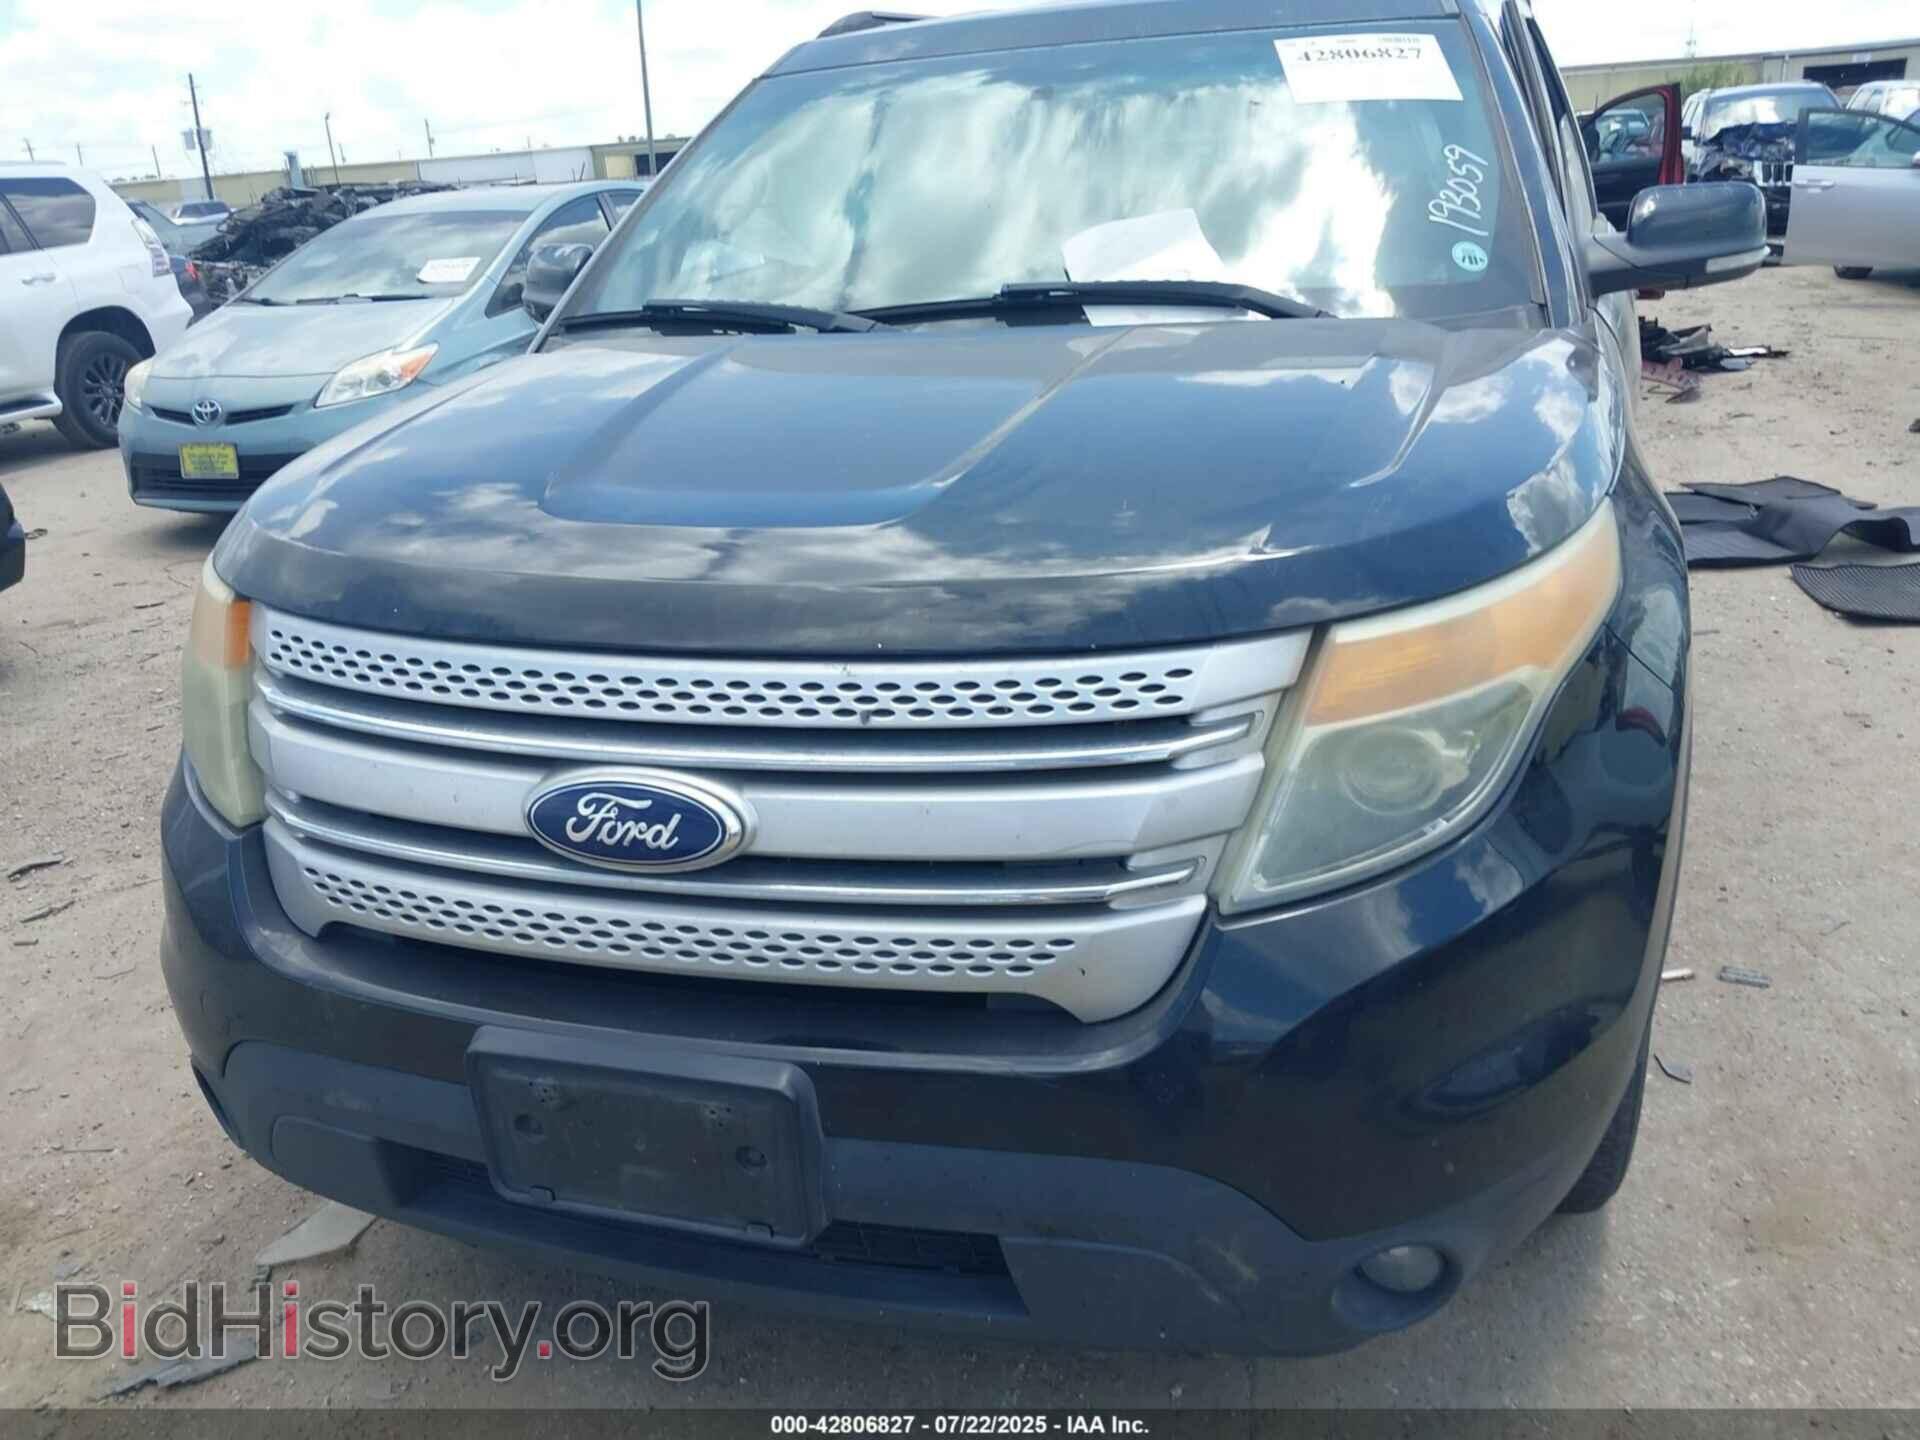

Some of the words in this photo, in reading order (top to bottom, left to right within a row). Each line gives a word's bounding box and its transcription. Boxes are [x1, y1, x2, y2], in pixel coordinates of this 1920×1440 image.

[1297, 47, 1422, 62] 42806827
[1428, 143, 1489, 237] 193059
[565, 792, 682, 850] Ford
